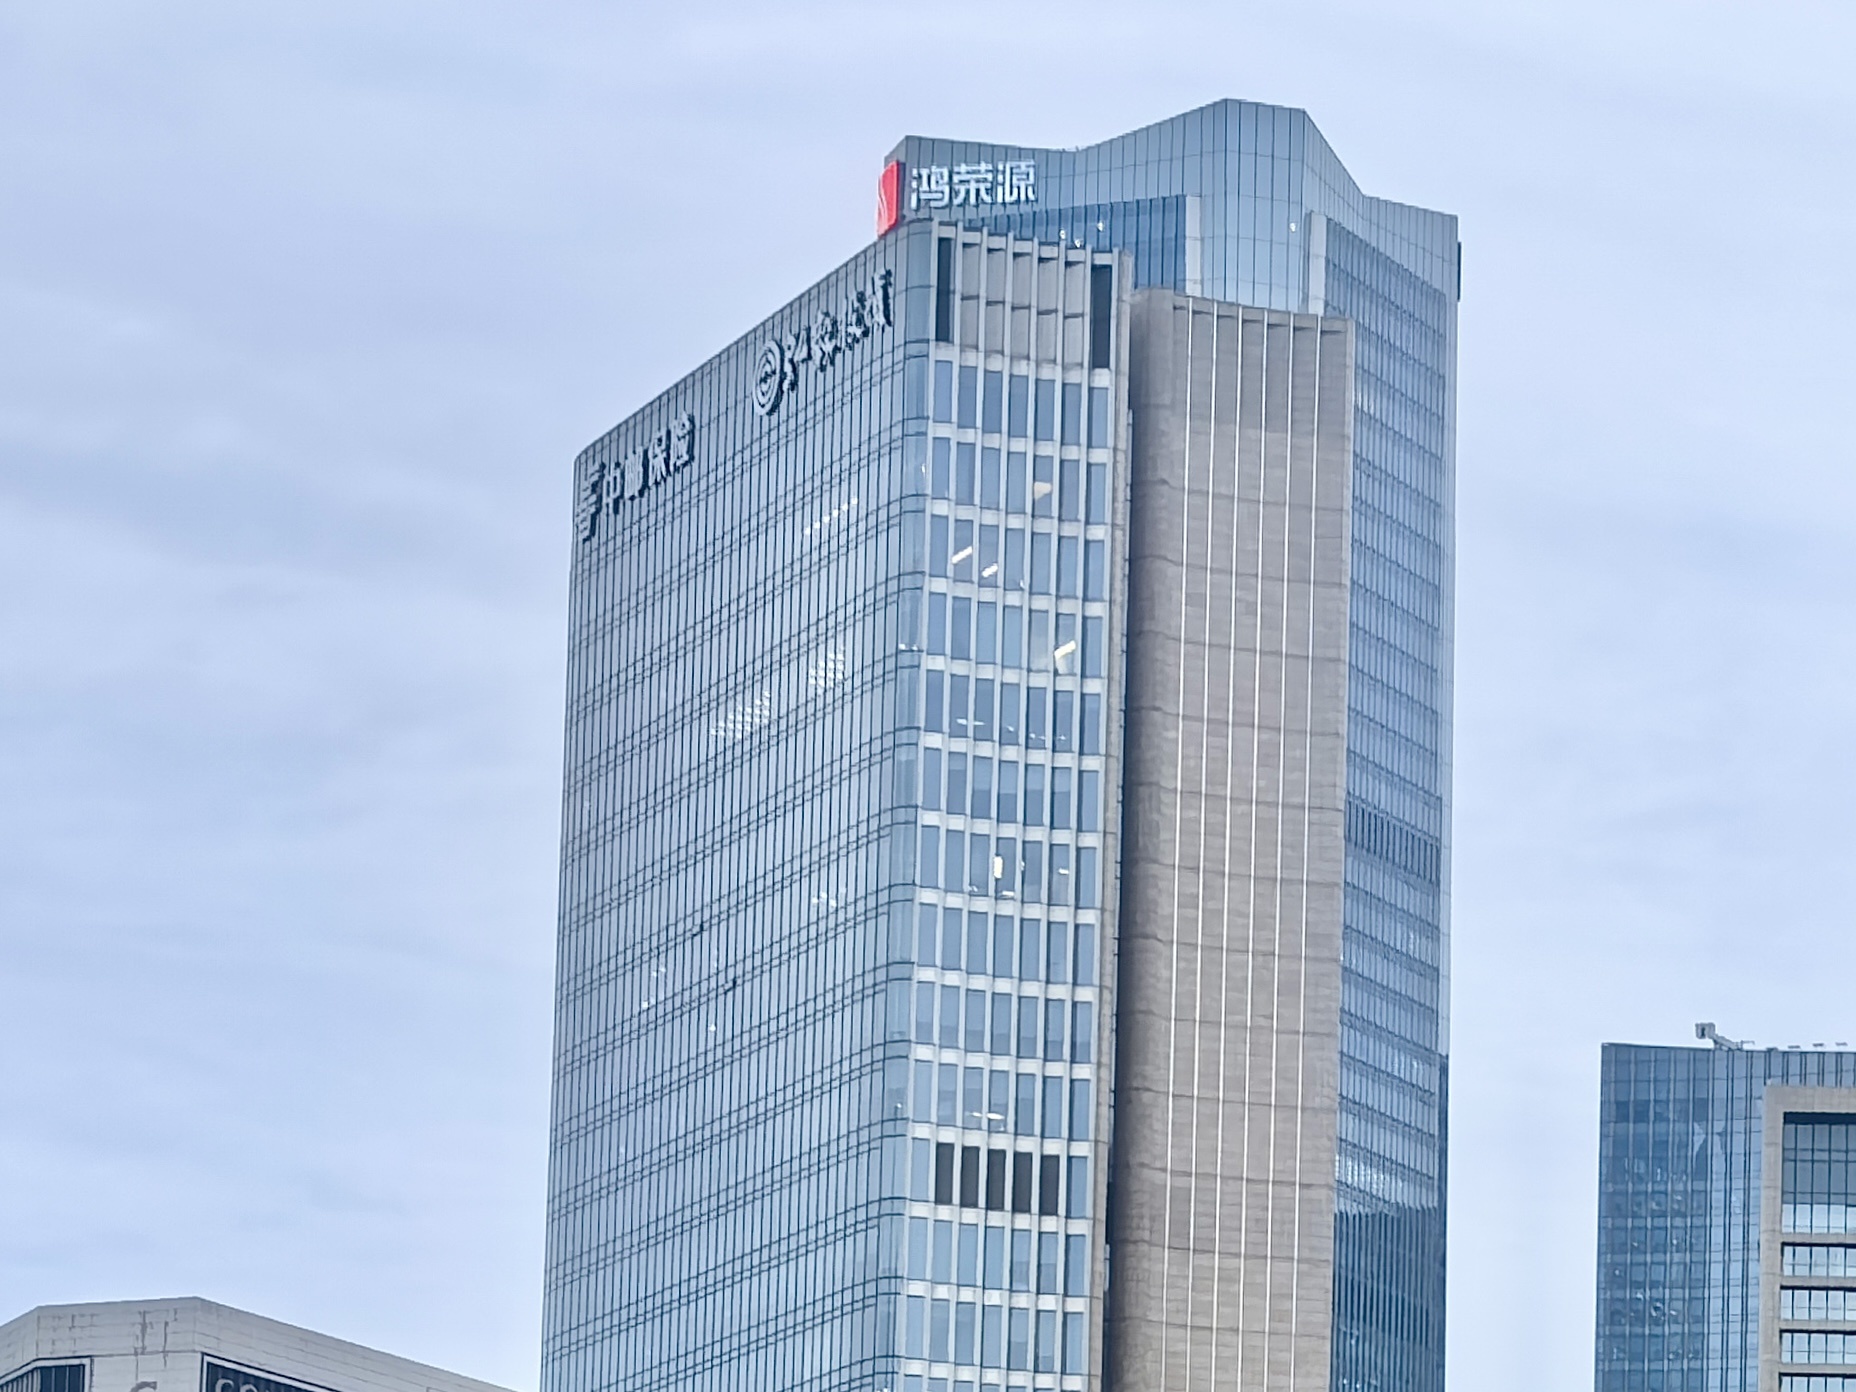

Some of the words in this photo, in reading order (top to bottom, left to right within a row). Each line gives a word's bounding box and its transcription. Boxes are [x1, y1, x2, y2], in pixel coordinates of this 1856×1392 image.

[910, 159, 1036, 210] 鸿荣源
[602, 410, 695, 514] 中邮保险
